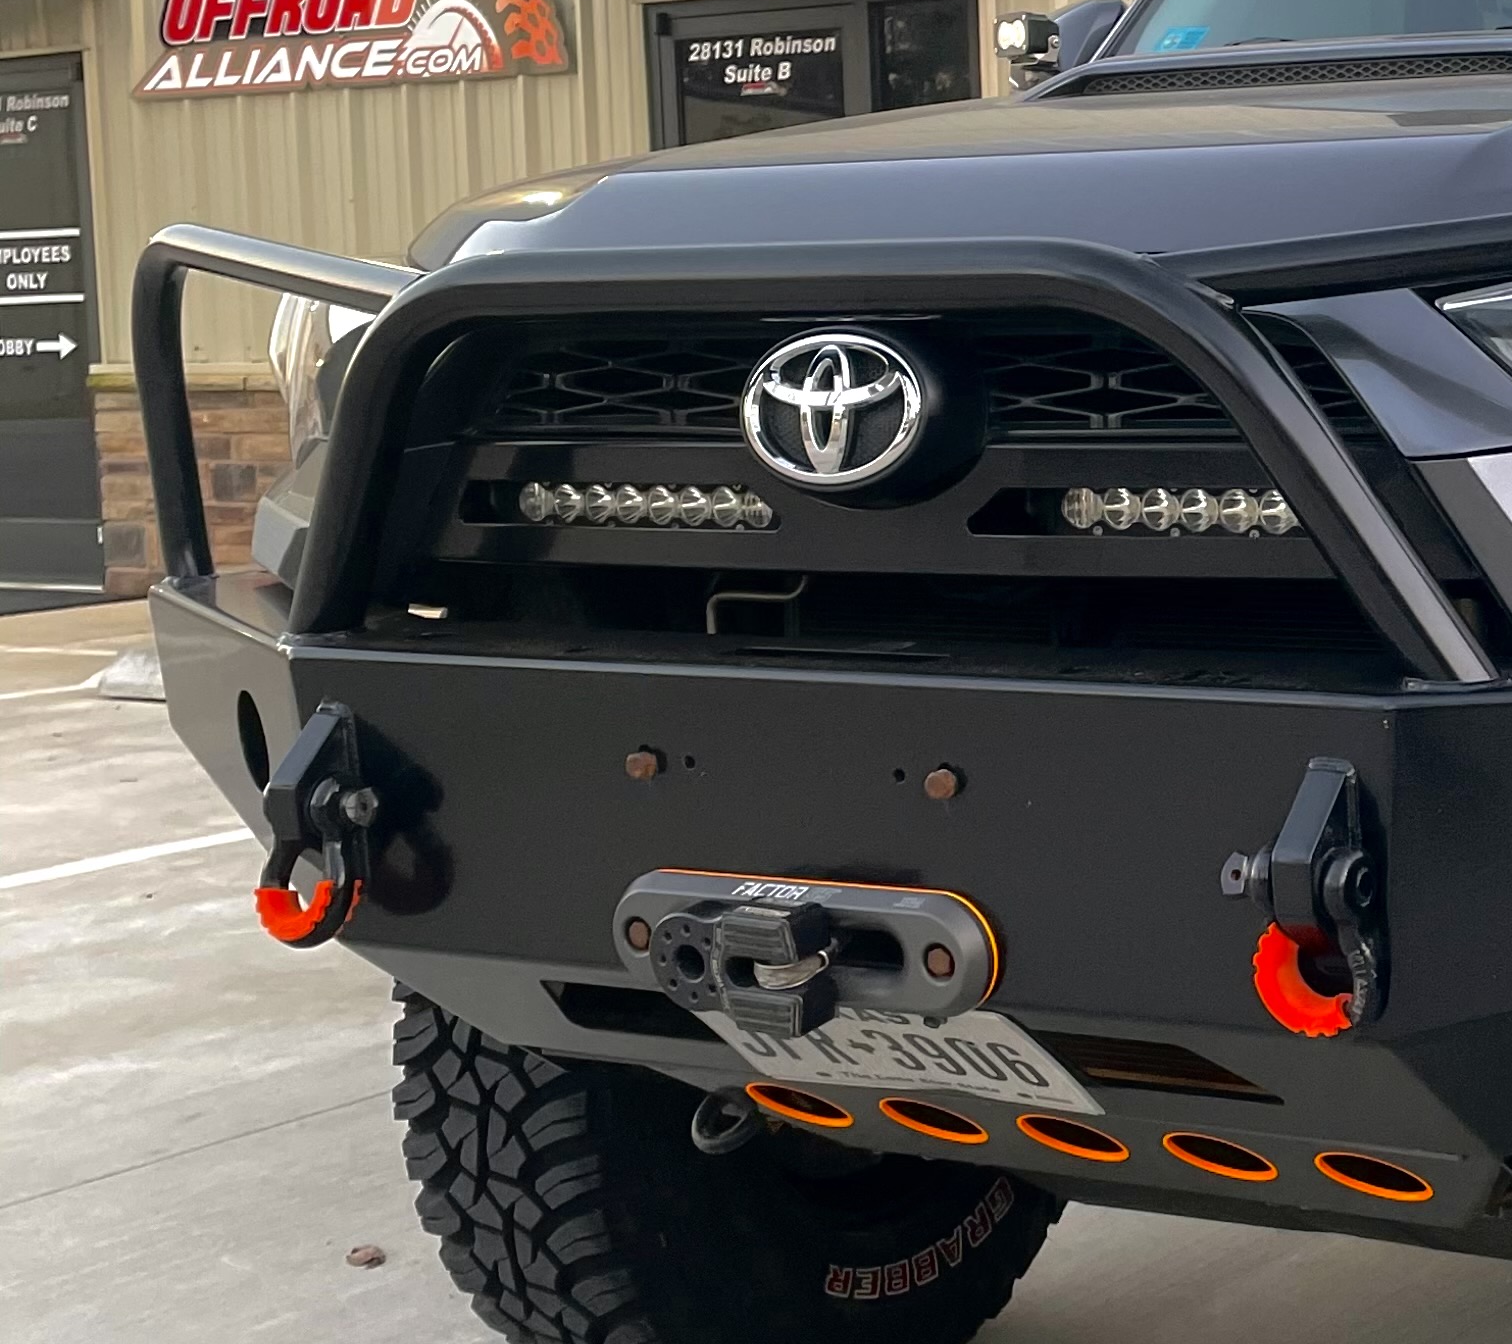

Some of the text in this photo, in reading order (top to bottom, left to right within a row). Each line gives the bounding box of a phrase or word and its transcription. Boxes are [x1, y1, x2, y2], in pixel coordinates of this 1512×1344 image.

[688, 35, 837, 61] 28131 Robinson
[724, 61, 791, 84] Suite B
[6, 93, 70, 112] Robinson
[27, 115, 39, 132] C
[0, 245, 71, 265] PLOYEES
[6, 271, 48, 290] ONLY
[824, 1175, 1015, 1300] GRABBER
